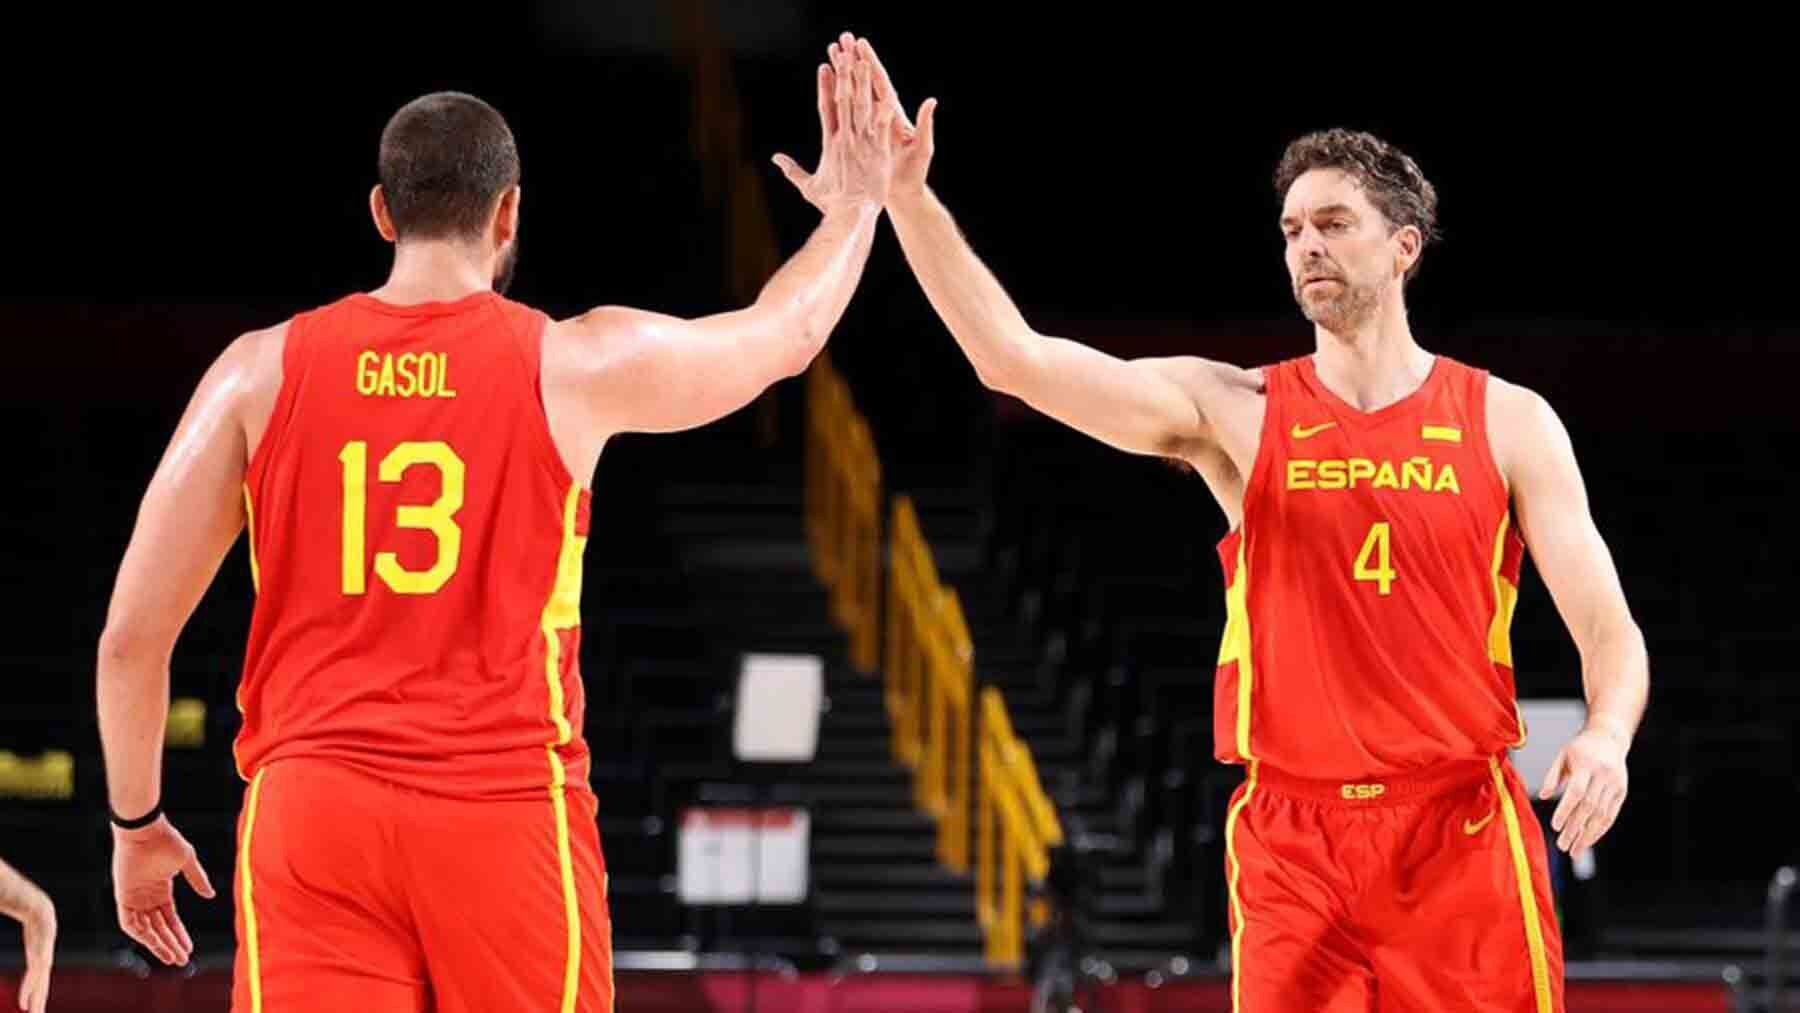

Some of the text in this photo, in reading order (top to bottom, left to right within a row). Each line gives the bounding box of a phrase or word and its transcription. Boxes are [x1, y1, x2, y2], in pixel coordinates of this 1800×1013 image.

[357, 350, 456, 398] GASOL
[1286, 456, 1461, 494] ESPAÑA
[339, 440, 465, 595] 13
[1353, 522, 1396, 595] 4
[1341, 783, 1385, 799] ESP
